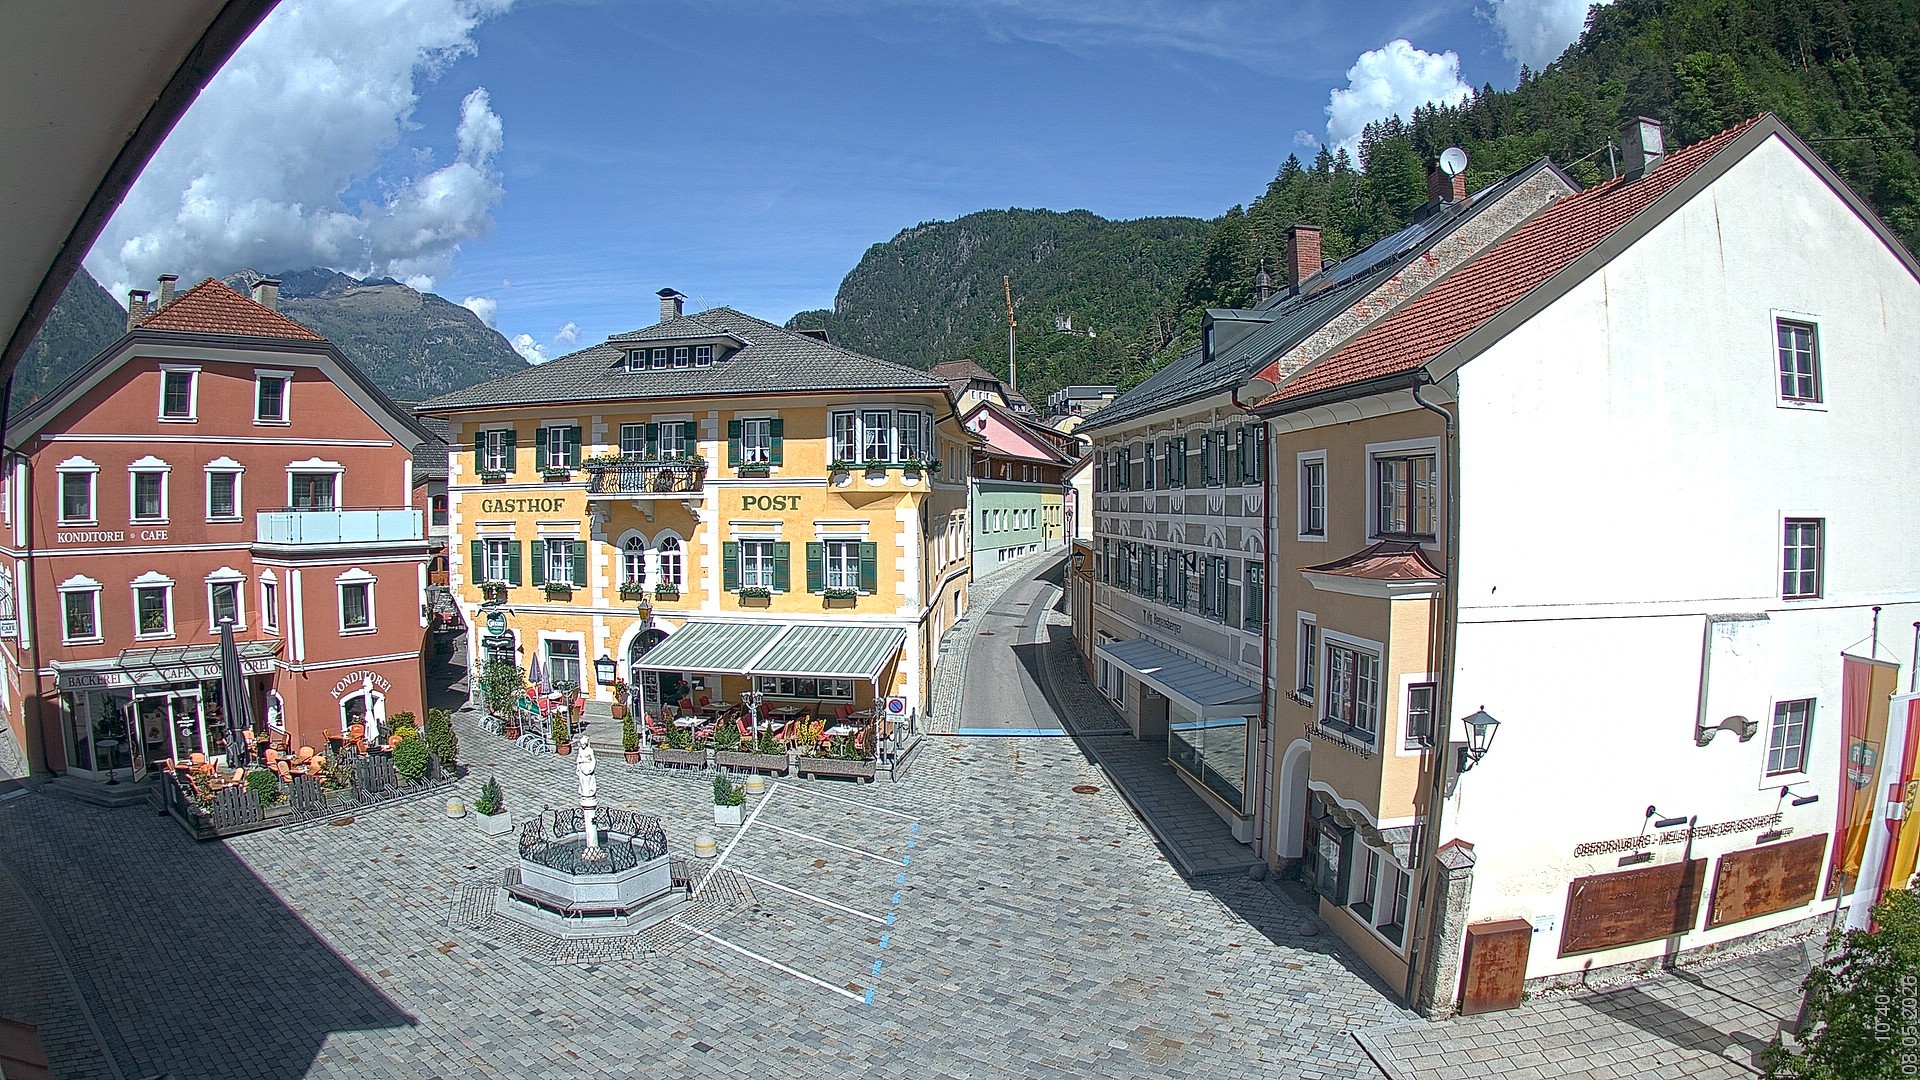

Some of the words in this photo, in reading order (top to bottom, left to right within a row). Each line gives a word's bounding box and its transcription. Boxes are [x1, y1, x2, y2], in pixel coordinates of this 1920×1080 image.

[482, 498, 565, 513] GASTHOF
[741, 495, 802, 511] POST
[57, 531, 125, 543] KONDITOREI
[140, 530, 168, 541] CAFE
[68, 672, 121, 687] BÄCKEREI
[330, 670, 392, 699] KONDITOREI
